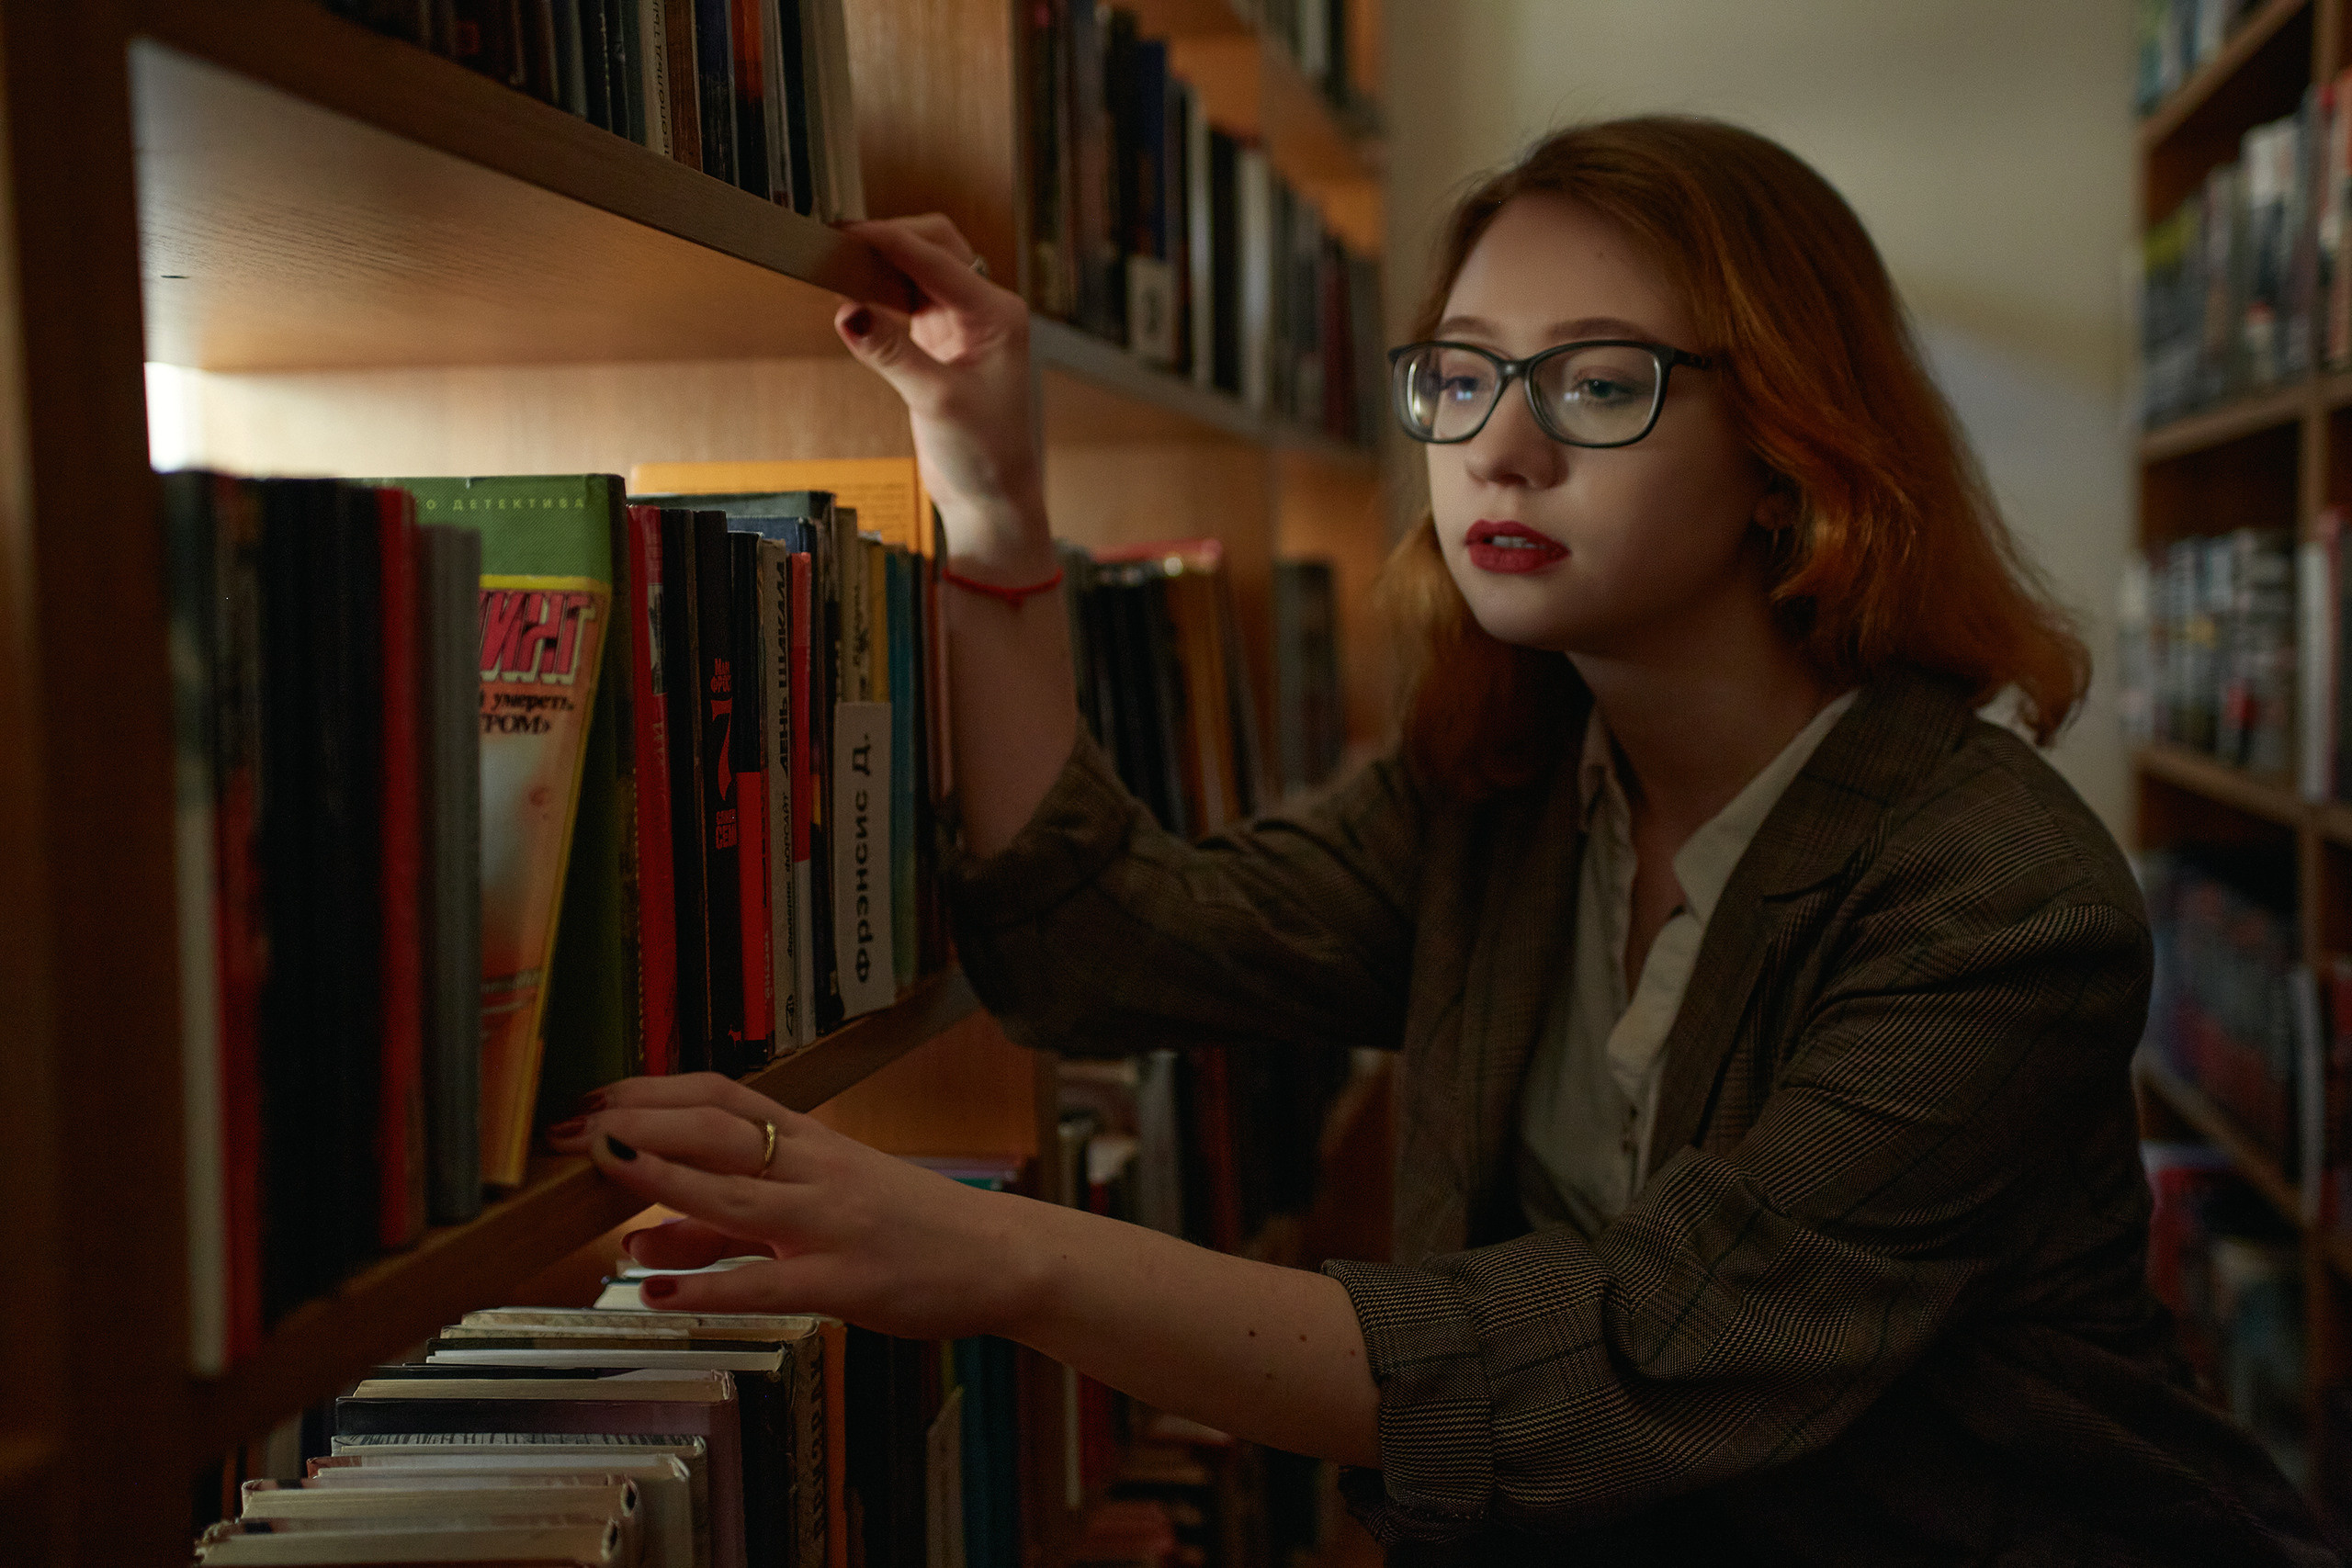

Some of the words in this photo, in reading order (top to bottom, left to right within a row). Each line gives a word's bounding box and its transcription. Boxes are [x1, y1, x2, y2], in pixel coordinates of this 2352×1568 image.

[453, 497, 585, 511] ДЕТЕКТИВА
[479, 592, 595, 686] ИНГ
[775, 561, 786, 688] ШАКАЛА
[710, 696, 733, 802] 7
[779, 697, 788, 779] ДЕНЬ
[853, 734, 872, 776] Д.
[782, 792, 791, 874] ФОРСАЙТ
[855, 789, 874, 983] Фрэнсис
